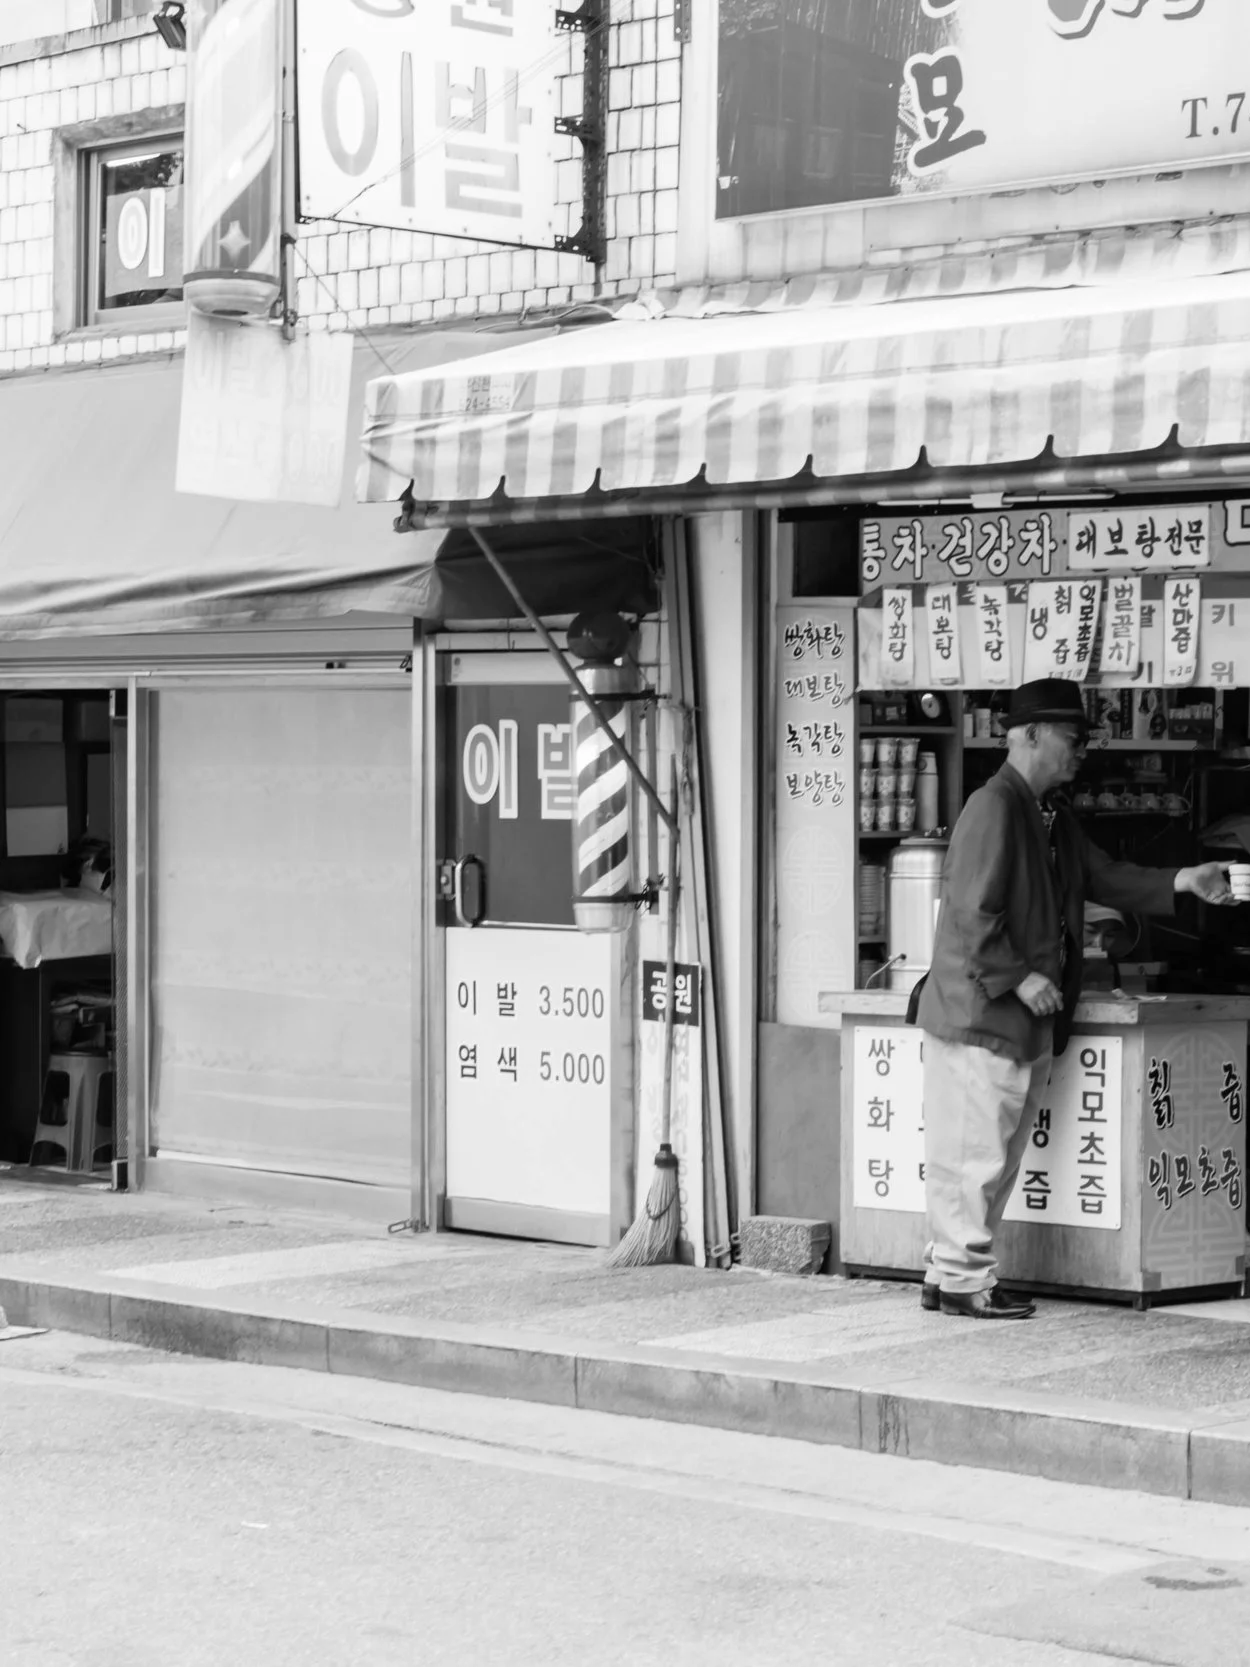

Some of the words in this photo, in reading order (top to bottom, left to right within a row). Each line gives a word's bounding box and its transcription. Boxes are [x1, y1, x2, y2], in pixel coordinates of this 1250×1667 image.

[321, 46, 532, 218] 이발
[931, 593, 954, 660] 대보탕
[785, 672, 845, 708] 대보탕
[786, 722, 845, 757] 녹각탕
[786, 770, 845, 807] 보양탕
[539, 985, 605, 1018] 3.500
[539, 1051, 606, 1085] 5.000
[1077, 1047, 1108, 1215] 익모초즙
[1147, 1145, 1243, 1210] 익모초즙
